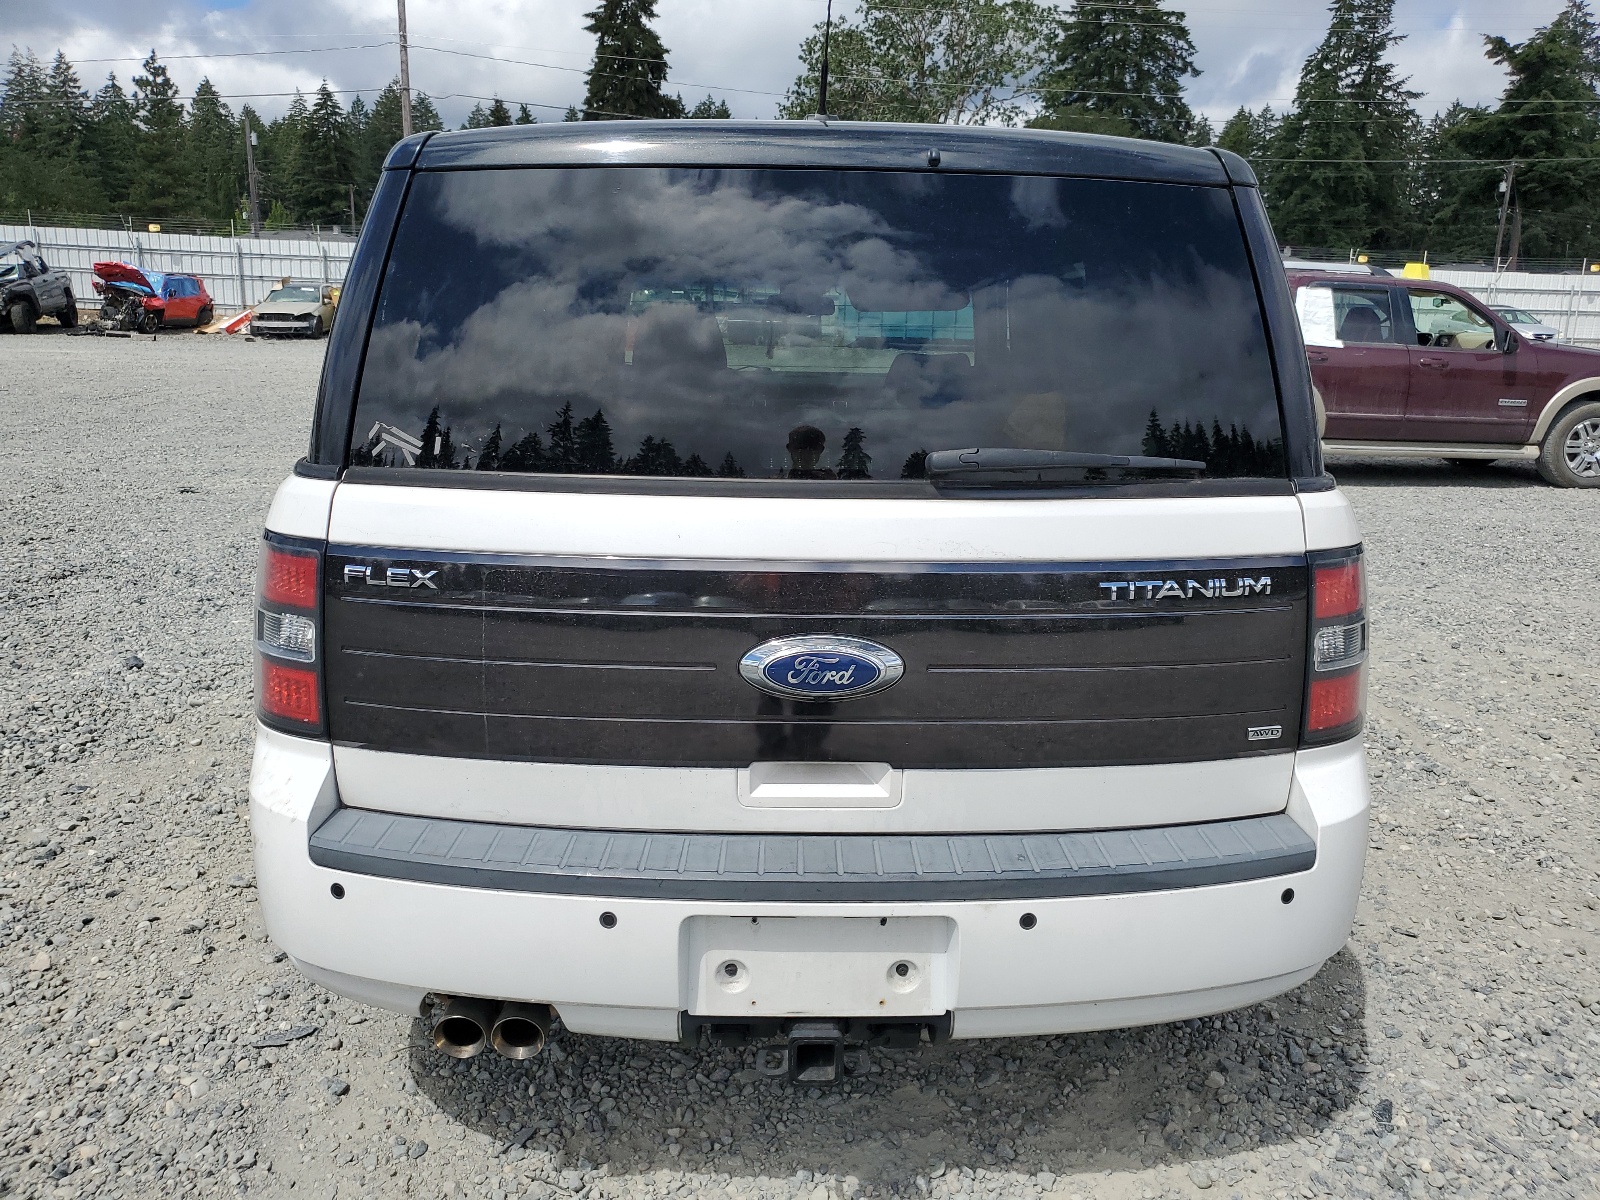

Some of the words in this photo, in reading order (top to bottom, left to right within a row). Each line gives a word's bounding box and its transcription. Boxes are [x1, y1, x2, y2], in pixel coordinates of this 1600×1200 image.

[343, 564, 438, 589] FLEX
[1099, 576, 1272, 600] TITANIUM
[787, 656, 856, 685] Ford
[1250, 728, 1281, 738] AWD
